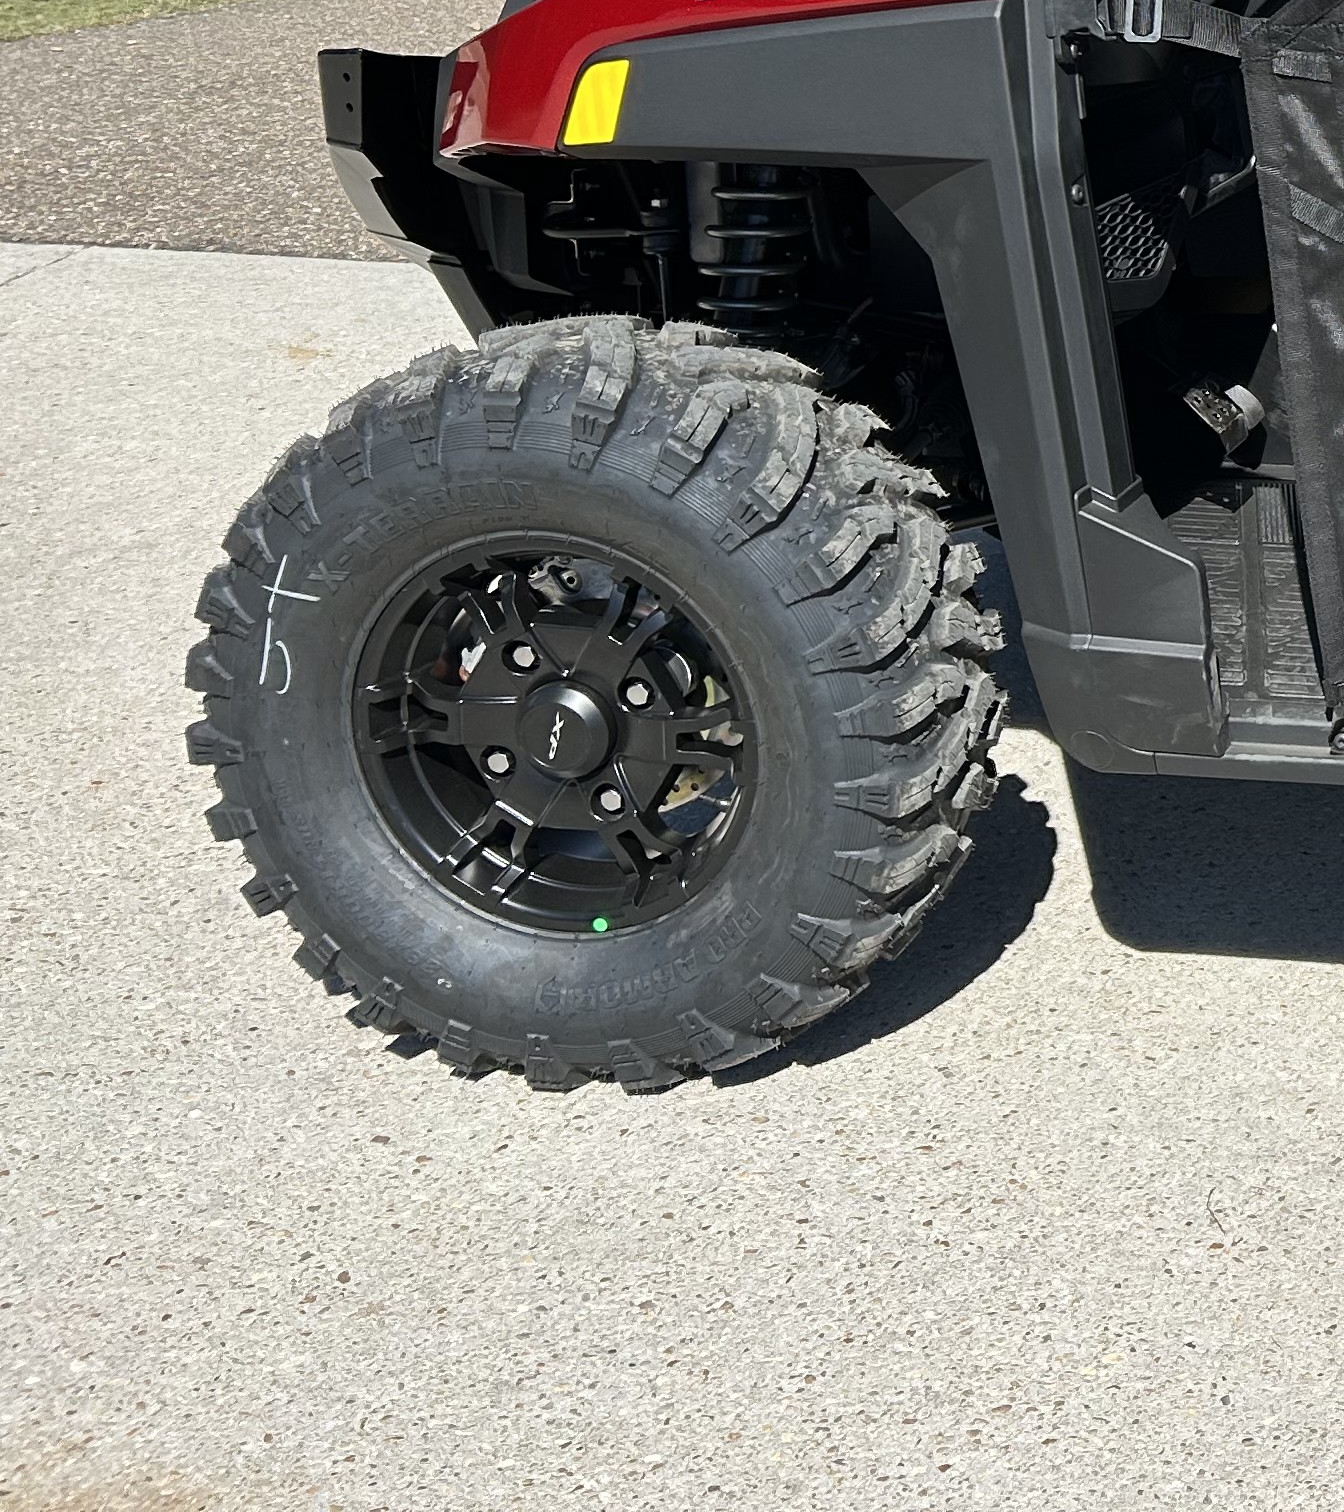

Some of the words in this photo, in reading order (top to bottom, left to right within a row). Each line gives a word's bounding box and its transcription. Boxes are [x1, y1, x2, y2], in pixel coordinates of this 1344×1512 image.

[306, 478, 539, 597] X-TERRAIN
[549, 711, 565, 760] XP
[703, 900, 763, 965] PRO
